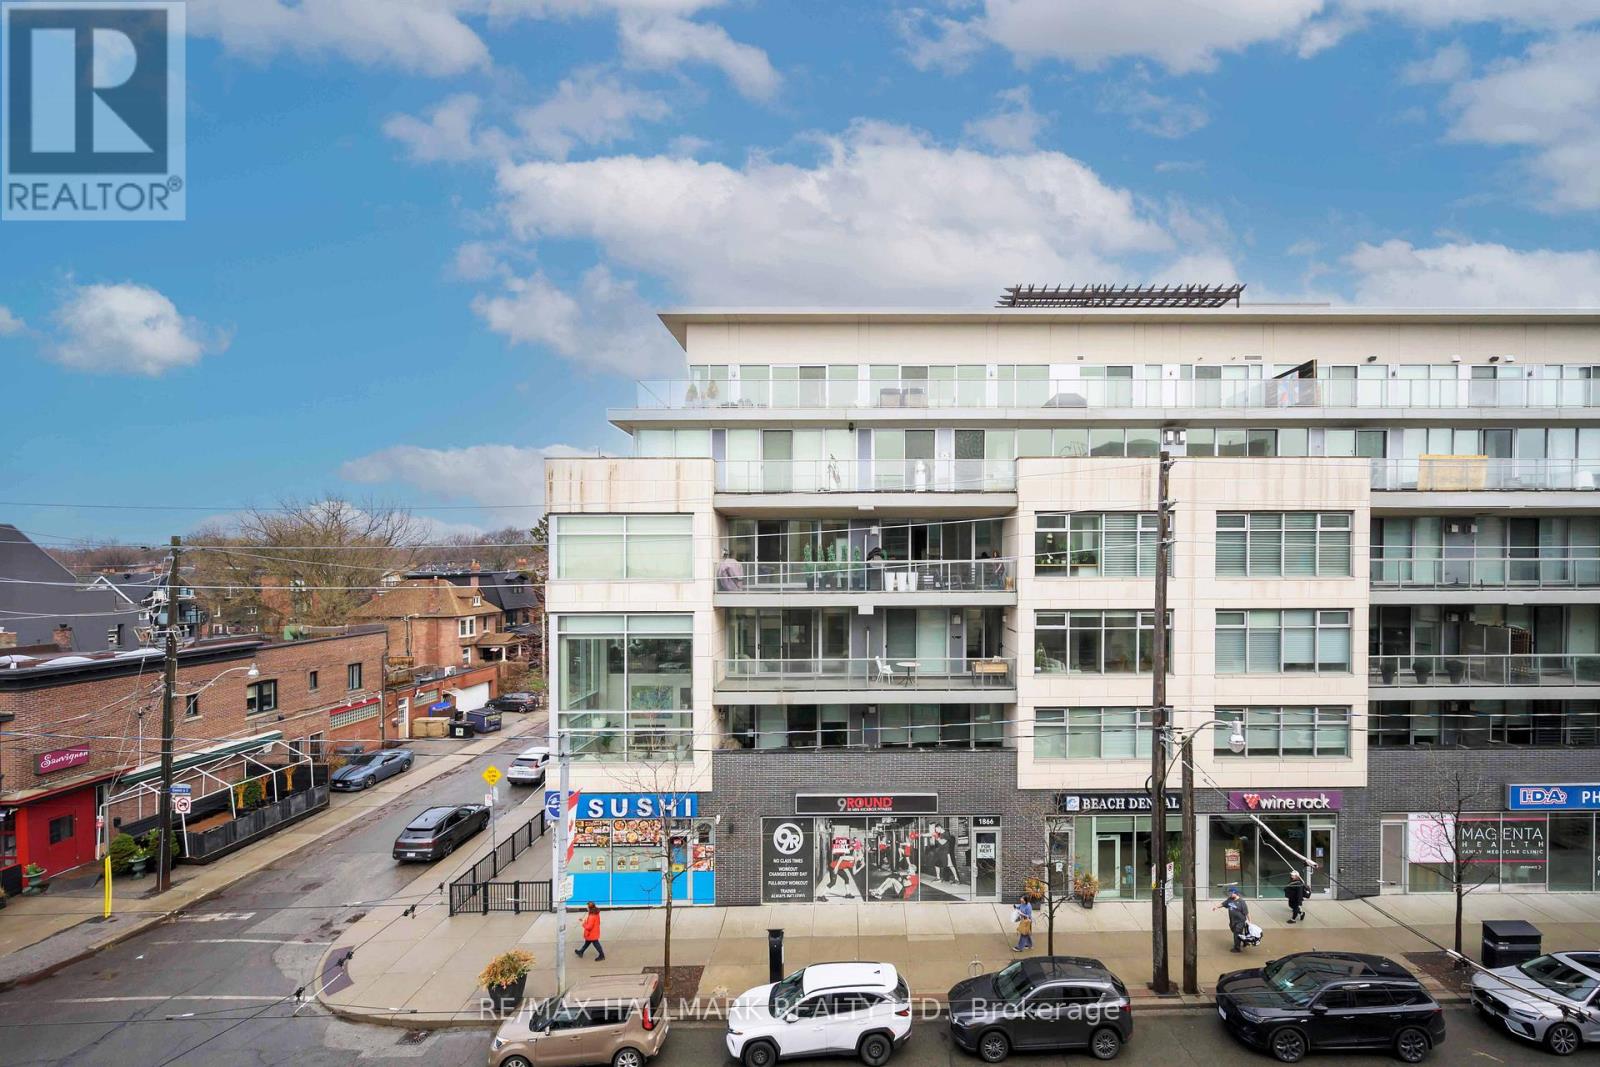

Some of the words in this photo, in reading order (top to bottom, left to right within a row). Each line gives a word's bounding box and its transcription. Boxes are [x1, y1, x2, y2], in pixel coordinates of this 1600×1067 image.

[40, 751, 89, 769] Sauvignon
[588, 798, 691, 818] SUSHI
[1081, 797, 1126, 810] BEACH
[1127, 797, 1180, 809] DENAL
[1260, 794, 1296, 809] wine
[1297, 793, 1331, 809] rack
[1461, 827, 1544, 841] MAGENTA
